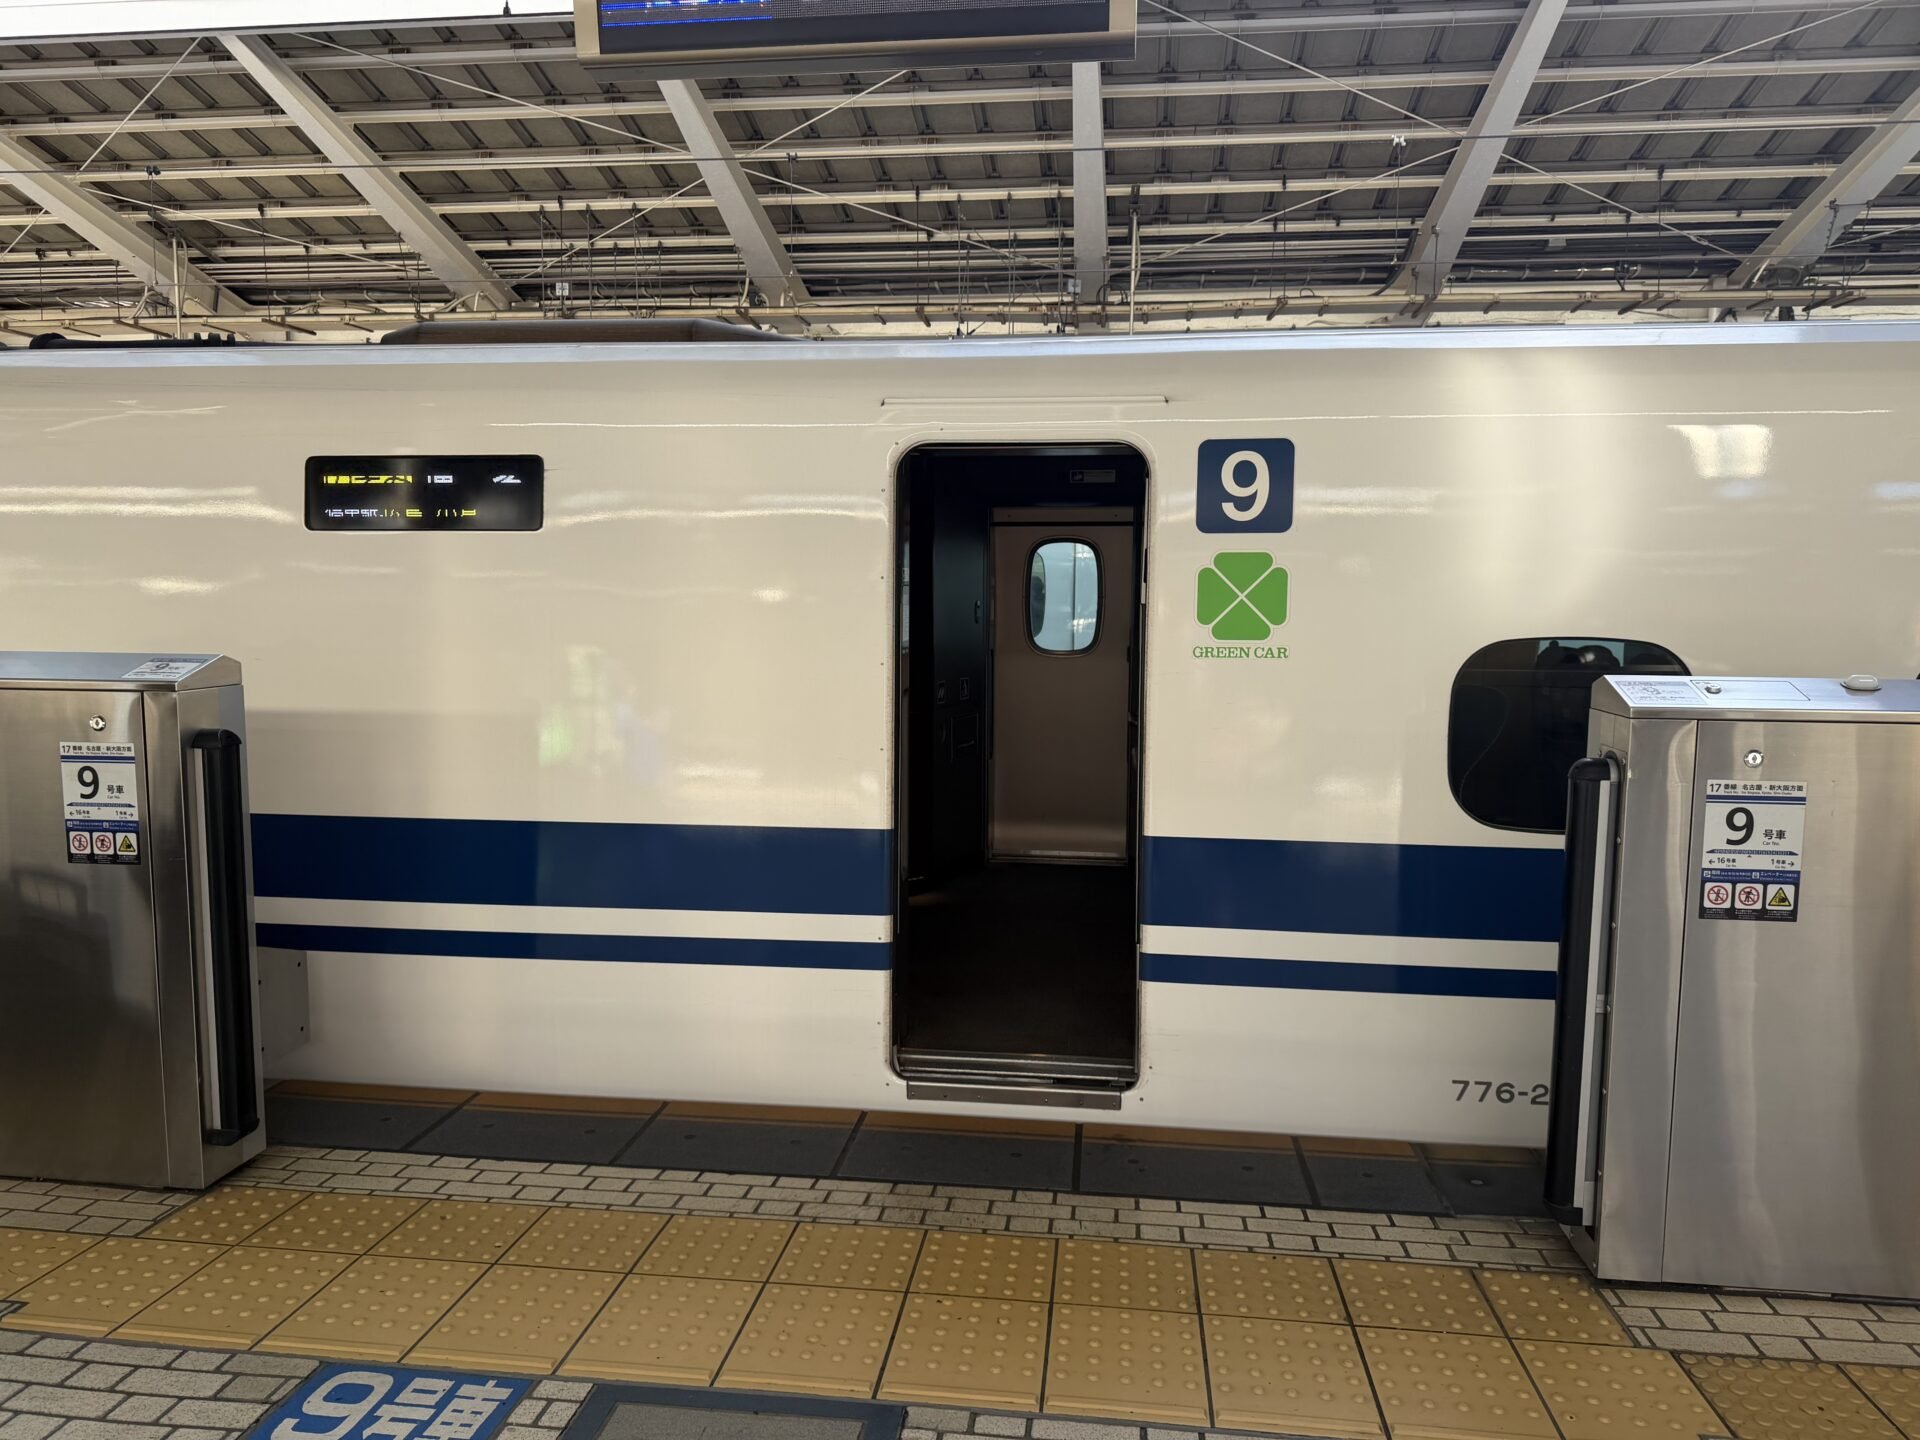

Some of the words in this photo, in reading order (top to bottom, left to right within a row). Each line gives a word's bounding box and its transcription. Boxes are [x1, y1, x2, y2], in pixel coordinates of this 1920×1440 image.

[1220, 450, 1270, 522] 9
[1192, 646, 1251, 659] GREEN
[1253, 646, 1289, 659] CAR
[61, 745, 71, 754] 17
[77, 765, 100, 800] 9
[106, 784, 125, 795] 号車
[1709, 783, 1722, 793] 17
[1725, 807, 1755, 846] 9
[1762, 829, 1787, 841] 号車
[1451, 1079, 1549, 1106] 776-2
